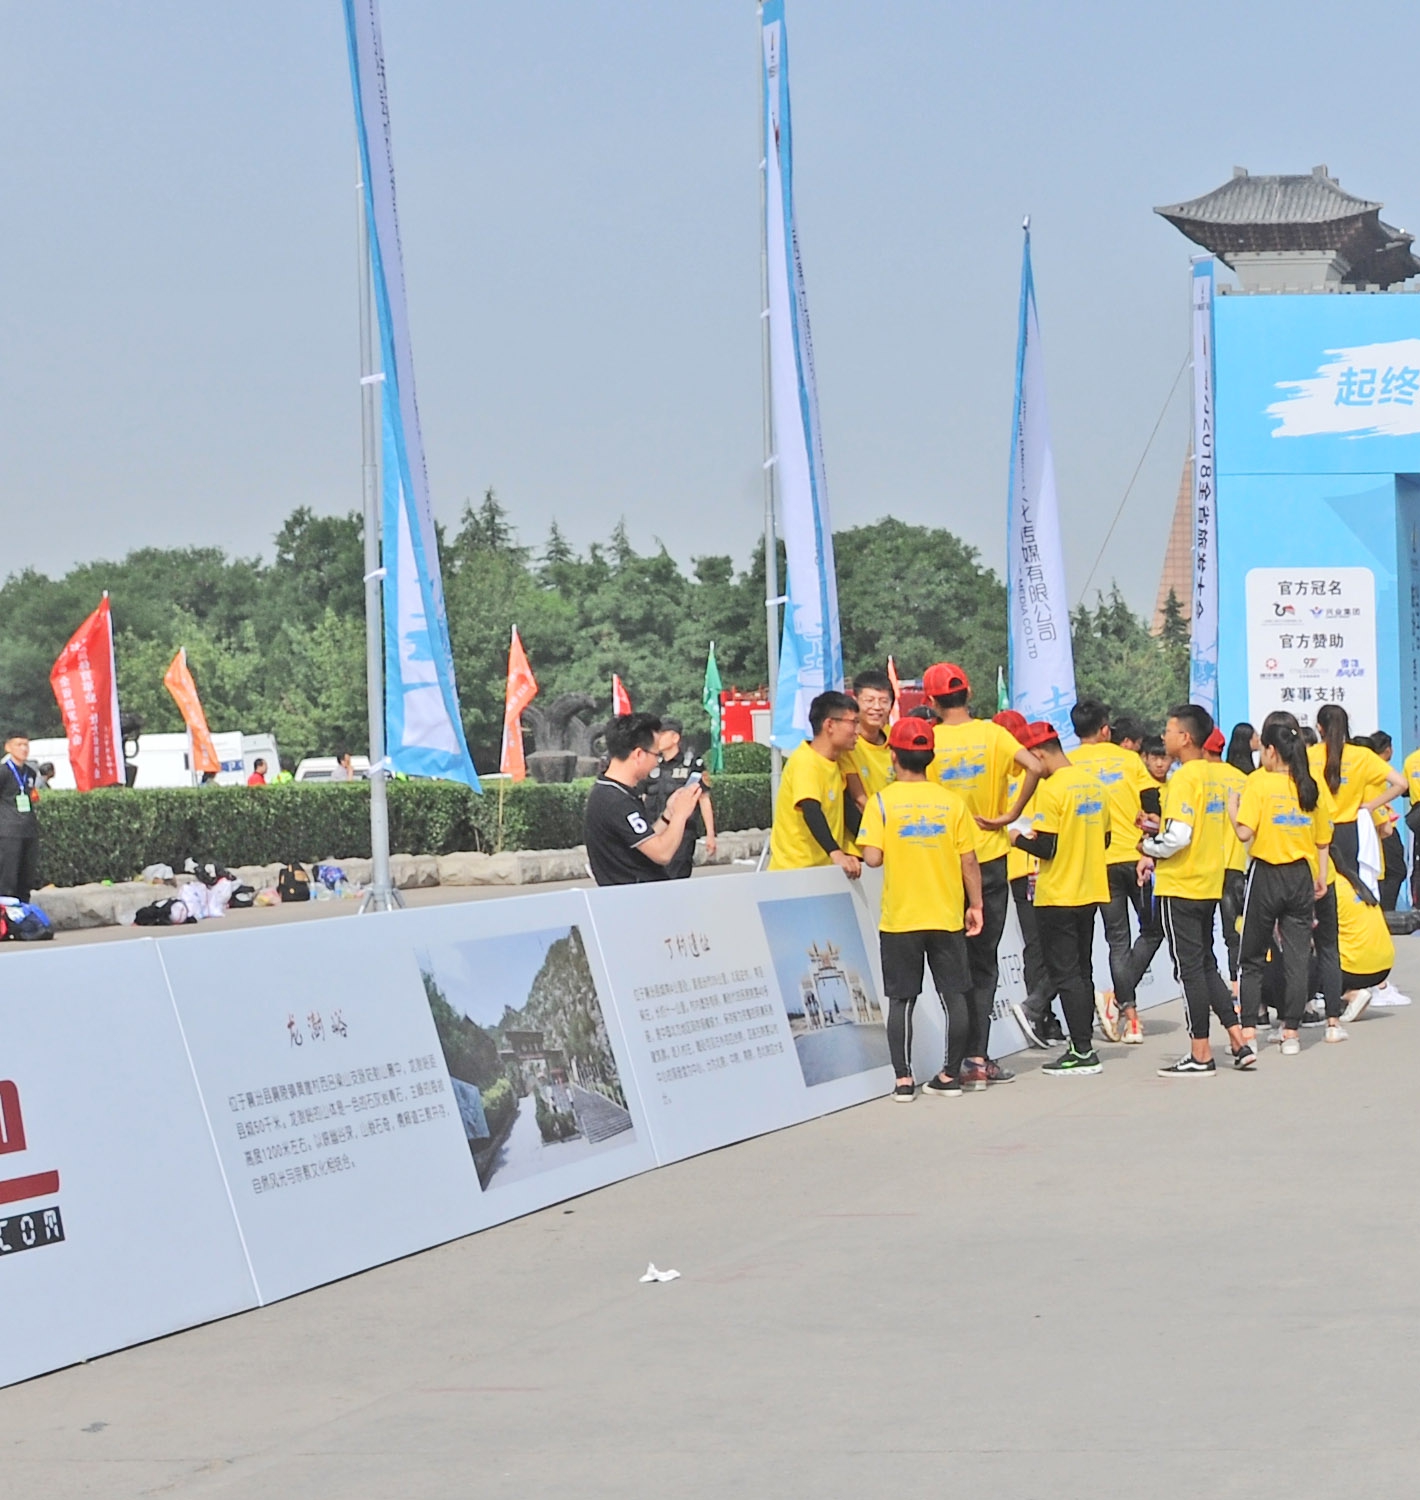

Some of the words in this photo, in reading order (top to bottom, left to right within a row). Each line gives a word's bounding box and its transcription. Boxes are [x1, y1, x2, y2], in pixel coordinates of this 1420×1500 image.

[1278, 580, 1342, 596] 官方冠名
[1279, 633, 1344, 649] 官方赞助
[1281, 687, 1345, 702] 赛事支持
[626, 811, 649, 835] 5
